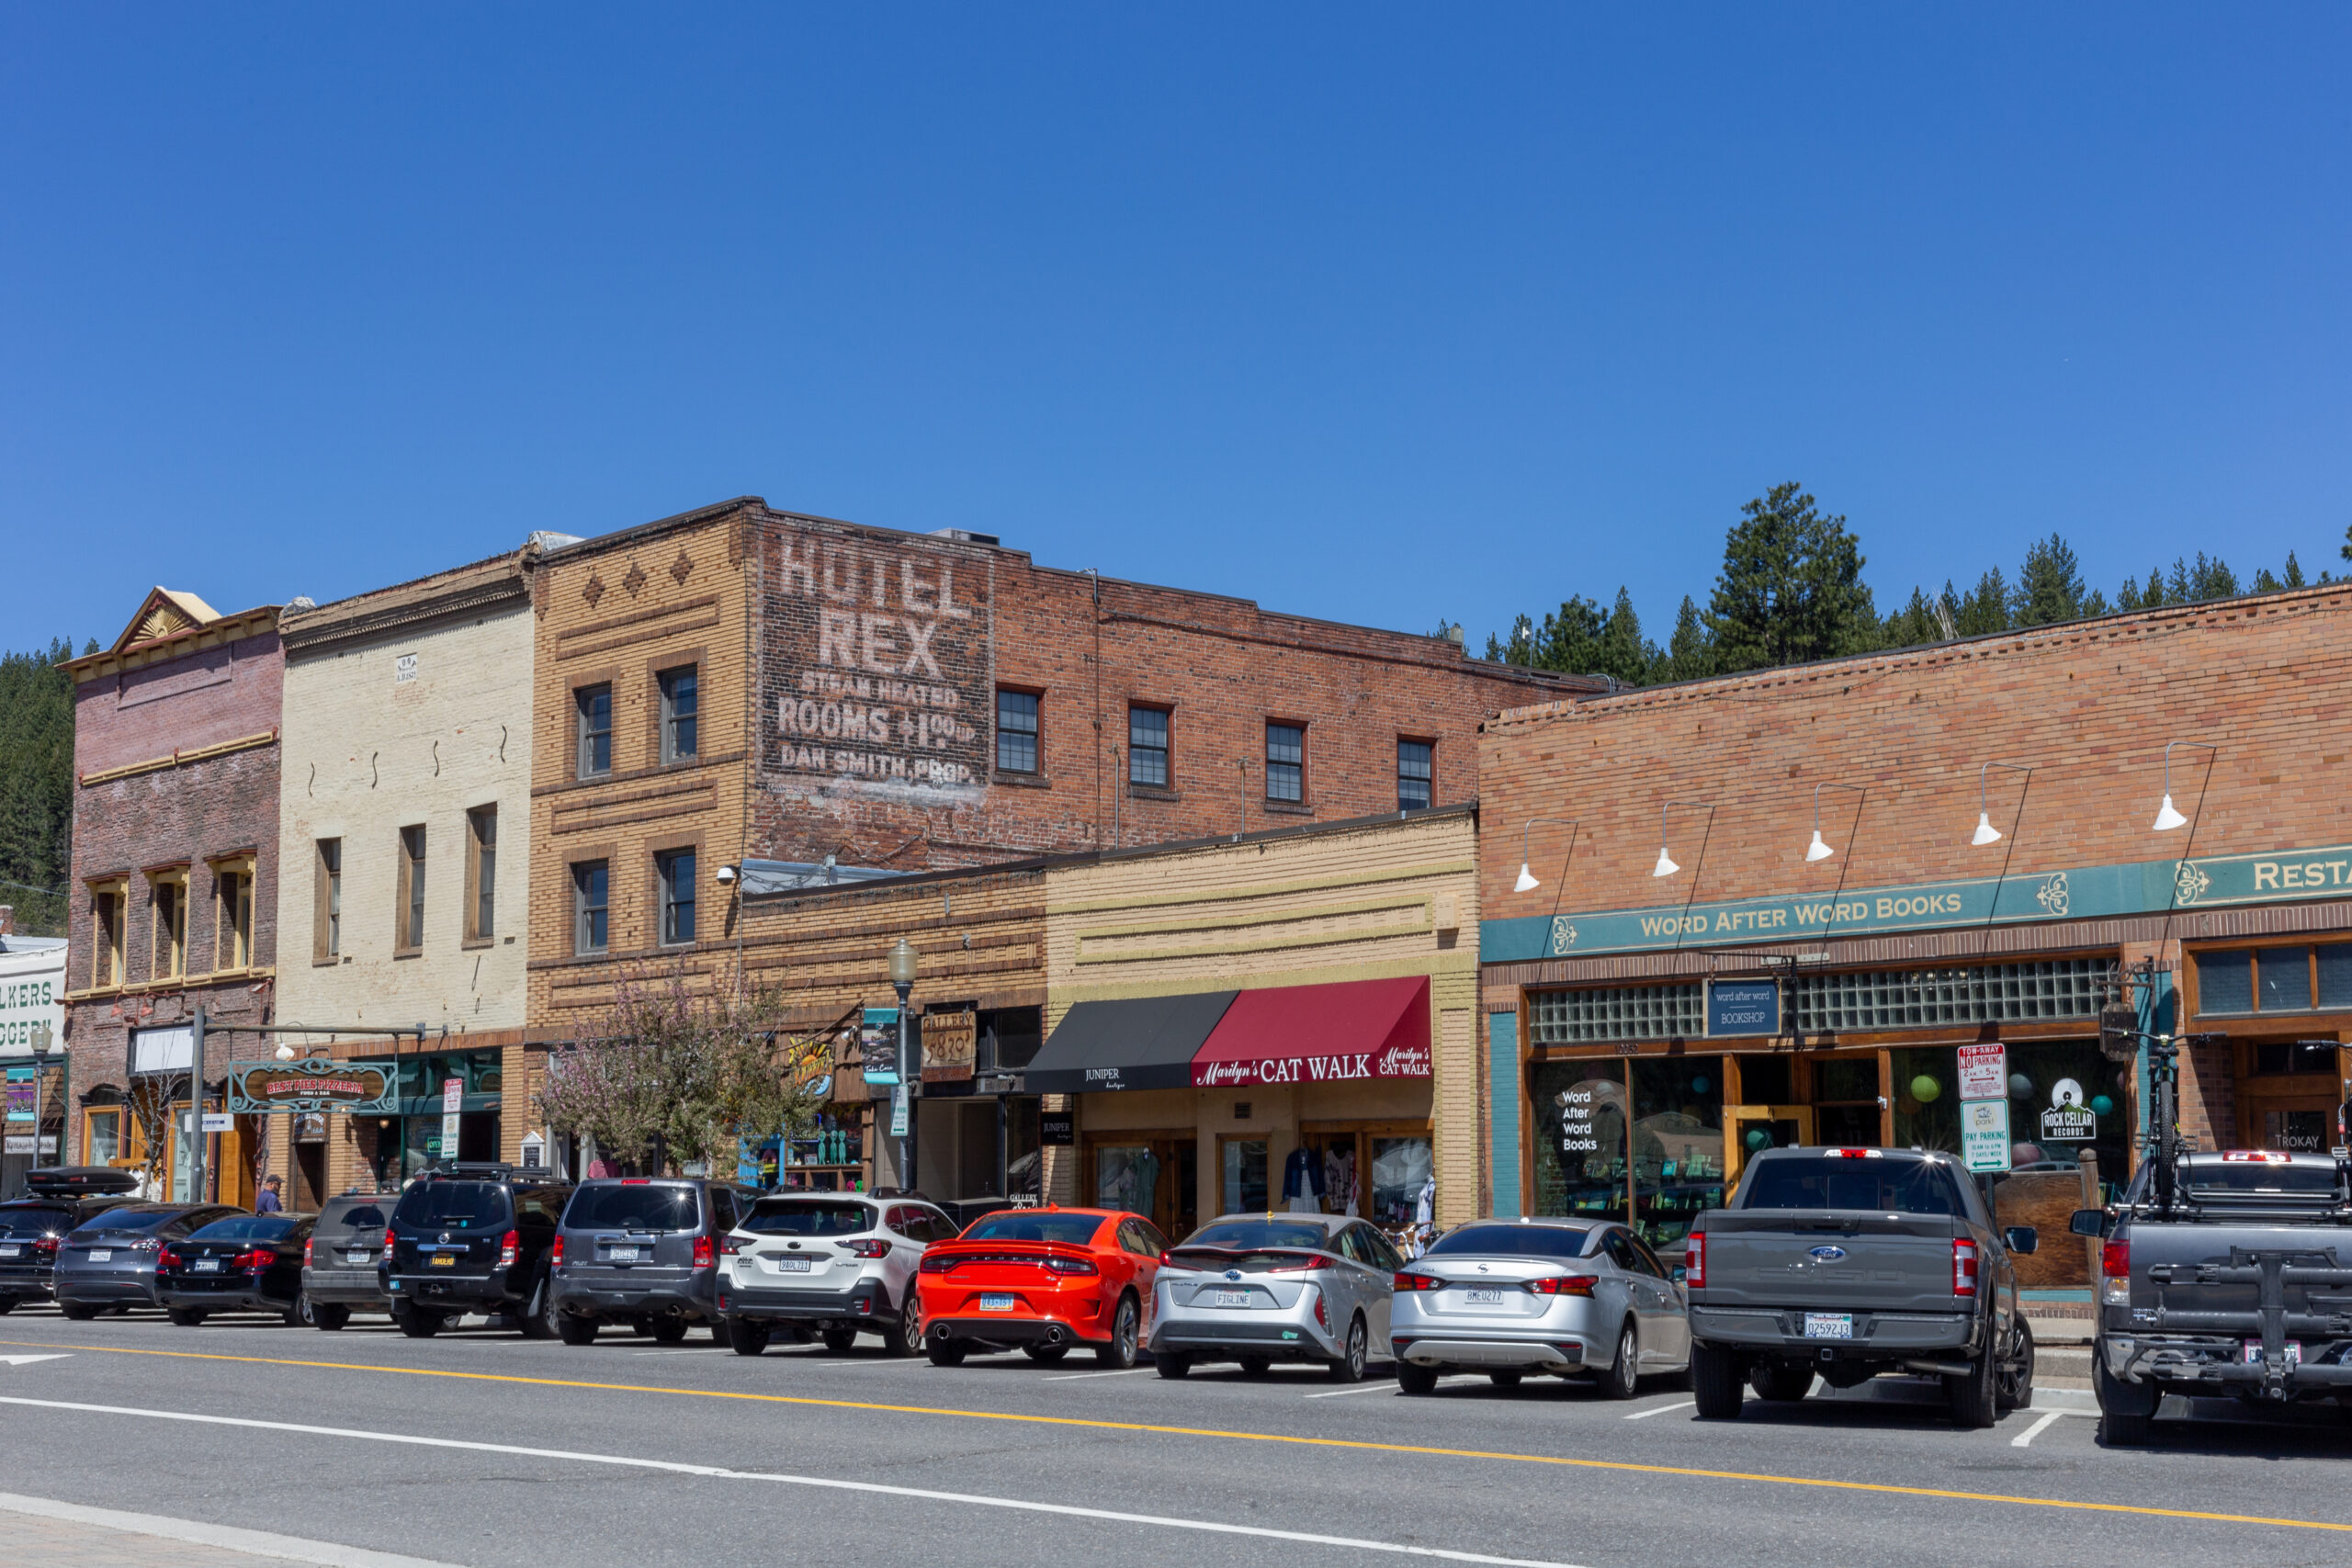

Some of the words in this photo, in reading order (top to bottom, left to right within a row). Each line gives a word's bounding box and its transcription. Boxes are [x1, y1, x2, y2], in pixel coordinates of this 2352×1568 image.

[781, 536, 972, 620] HOTEL
[819, 607, 945, 682] REX
[801, 671, 872, 697] STEAM
[878, 680, 958, 708] HEATED
[779, 696, 889, 742] ROOMS
[781, 745, 827, 770] DAN
[1641, 917, 1708, 937] WORD
[1714, 909, 1787, 931] AFTER
[1793, 902, 1869, 925] WORD
[1876, 894, 1962, 919] BOOKS
[0, 981, 51, 1010] LKERS
[1716, 991, 1734, 1001] word
[1735, 991, 1751, 1001] after
[1753, 991, 1770, 1001] word
[922, 1014, 973, 1031] GALLERY
[1721, 1011, 1766, 1024] BOOKSHOP
[1379, 1046, 1430, 1066] Marilyn's
[1962, 1045, 1999, 1055] TOW-AWAY
[1960, 1055, 1973, 1068] NO
[1974, 1055, 2001, 1066] PARKING
[1085, 1067, 1119, 1082] JUNIPER
[1196, 1059, 1258, 1086] Marilyn's
[1261, 1058, 1302, 1082] CAT
[1307, 1054, 1371, 1080] WALK
[1379, 1064, 1400, 1076] CAT
[1402, 1063, 1430, 1076] WALK
[266, 1080, 293, 1094] BEST
[294, 1078, 317, 1090] PIES
[318, 1079, 364, 1095] PIZZERIA
[1562, 1090, 1591, 1103] Word
[1563, 1106, 1589, 1119] After
[2044, 1111, 2064, 1128] ROCK
[2064, 1111, 2092, 1127] CELLAR
[1044, 1122, 1070, 1134] JUNIPER
[1563, 1122, 1592, 1135] Word
[2052, 1126, 2085, 1137] RECORDS
[1965, 1132, 1977, 1142] PAY
[1980, 1130, 2006, 1141] PARKING
[2275, 1134, 2319, 1148] TROKAY
[1564, 1137, 1598, 1151] Books
[1817, 1248, 1839, 1259] Ford
[1217, 1293, 1250, 1304] FIGLINE
